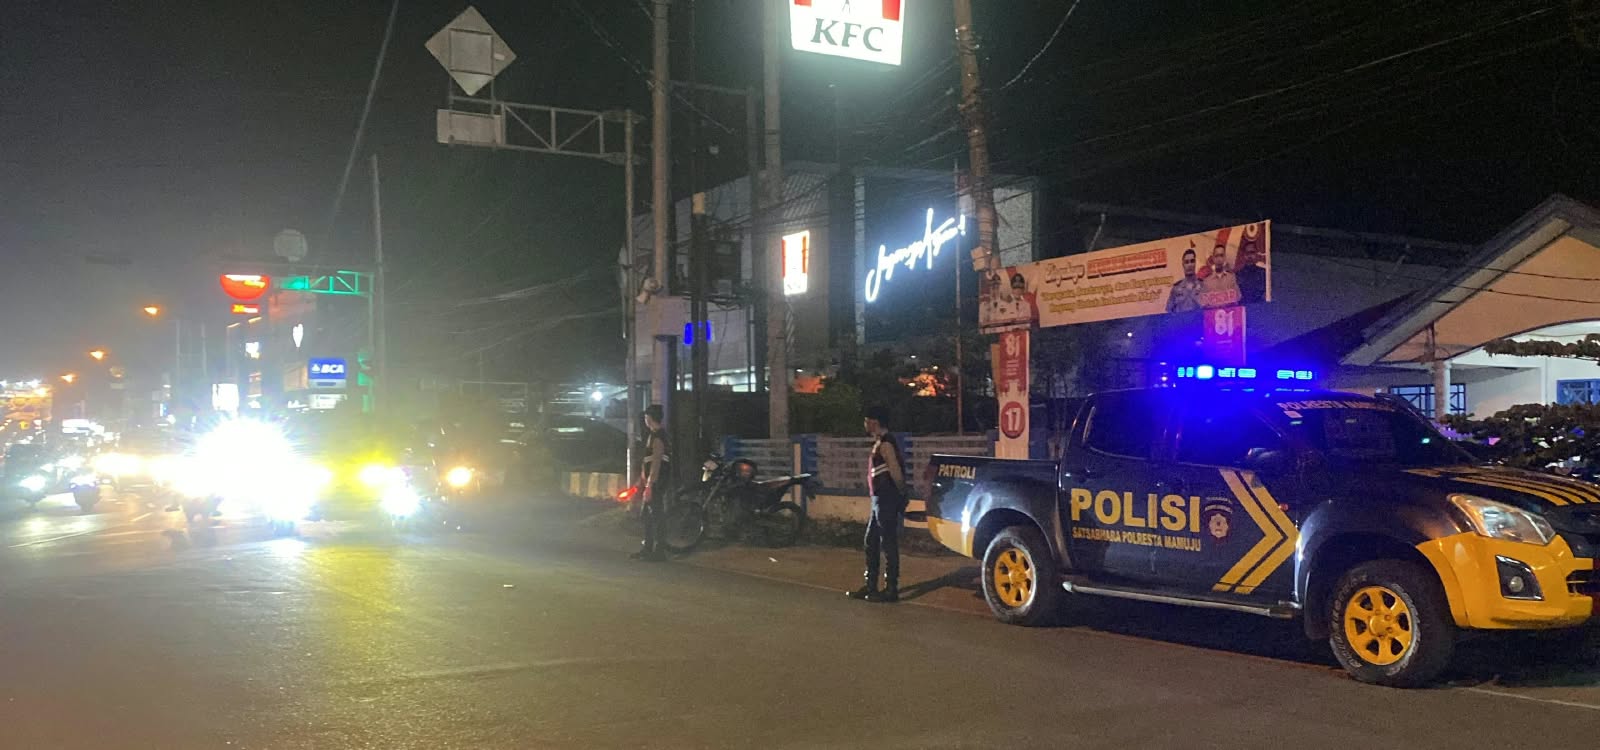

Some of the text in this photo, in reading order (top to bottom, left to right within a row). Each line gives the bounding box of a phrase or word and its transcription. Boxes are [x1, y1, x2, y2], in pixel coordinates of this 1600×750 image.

[811, 18, 884, 51] KFC
[320, 364, 345, 374] BCA
[1276, 399, 1347, 411] POLRESTA
[1006, 407, 1021, 432] 17
[938, 464, 976, 479] PATROLI
[1071, 488, 1200, 532] POLISI
[1072, 527, 1201, 551] SATSABHARA POLRESTA MAMUJU
